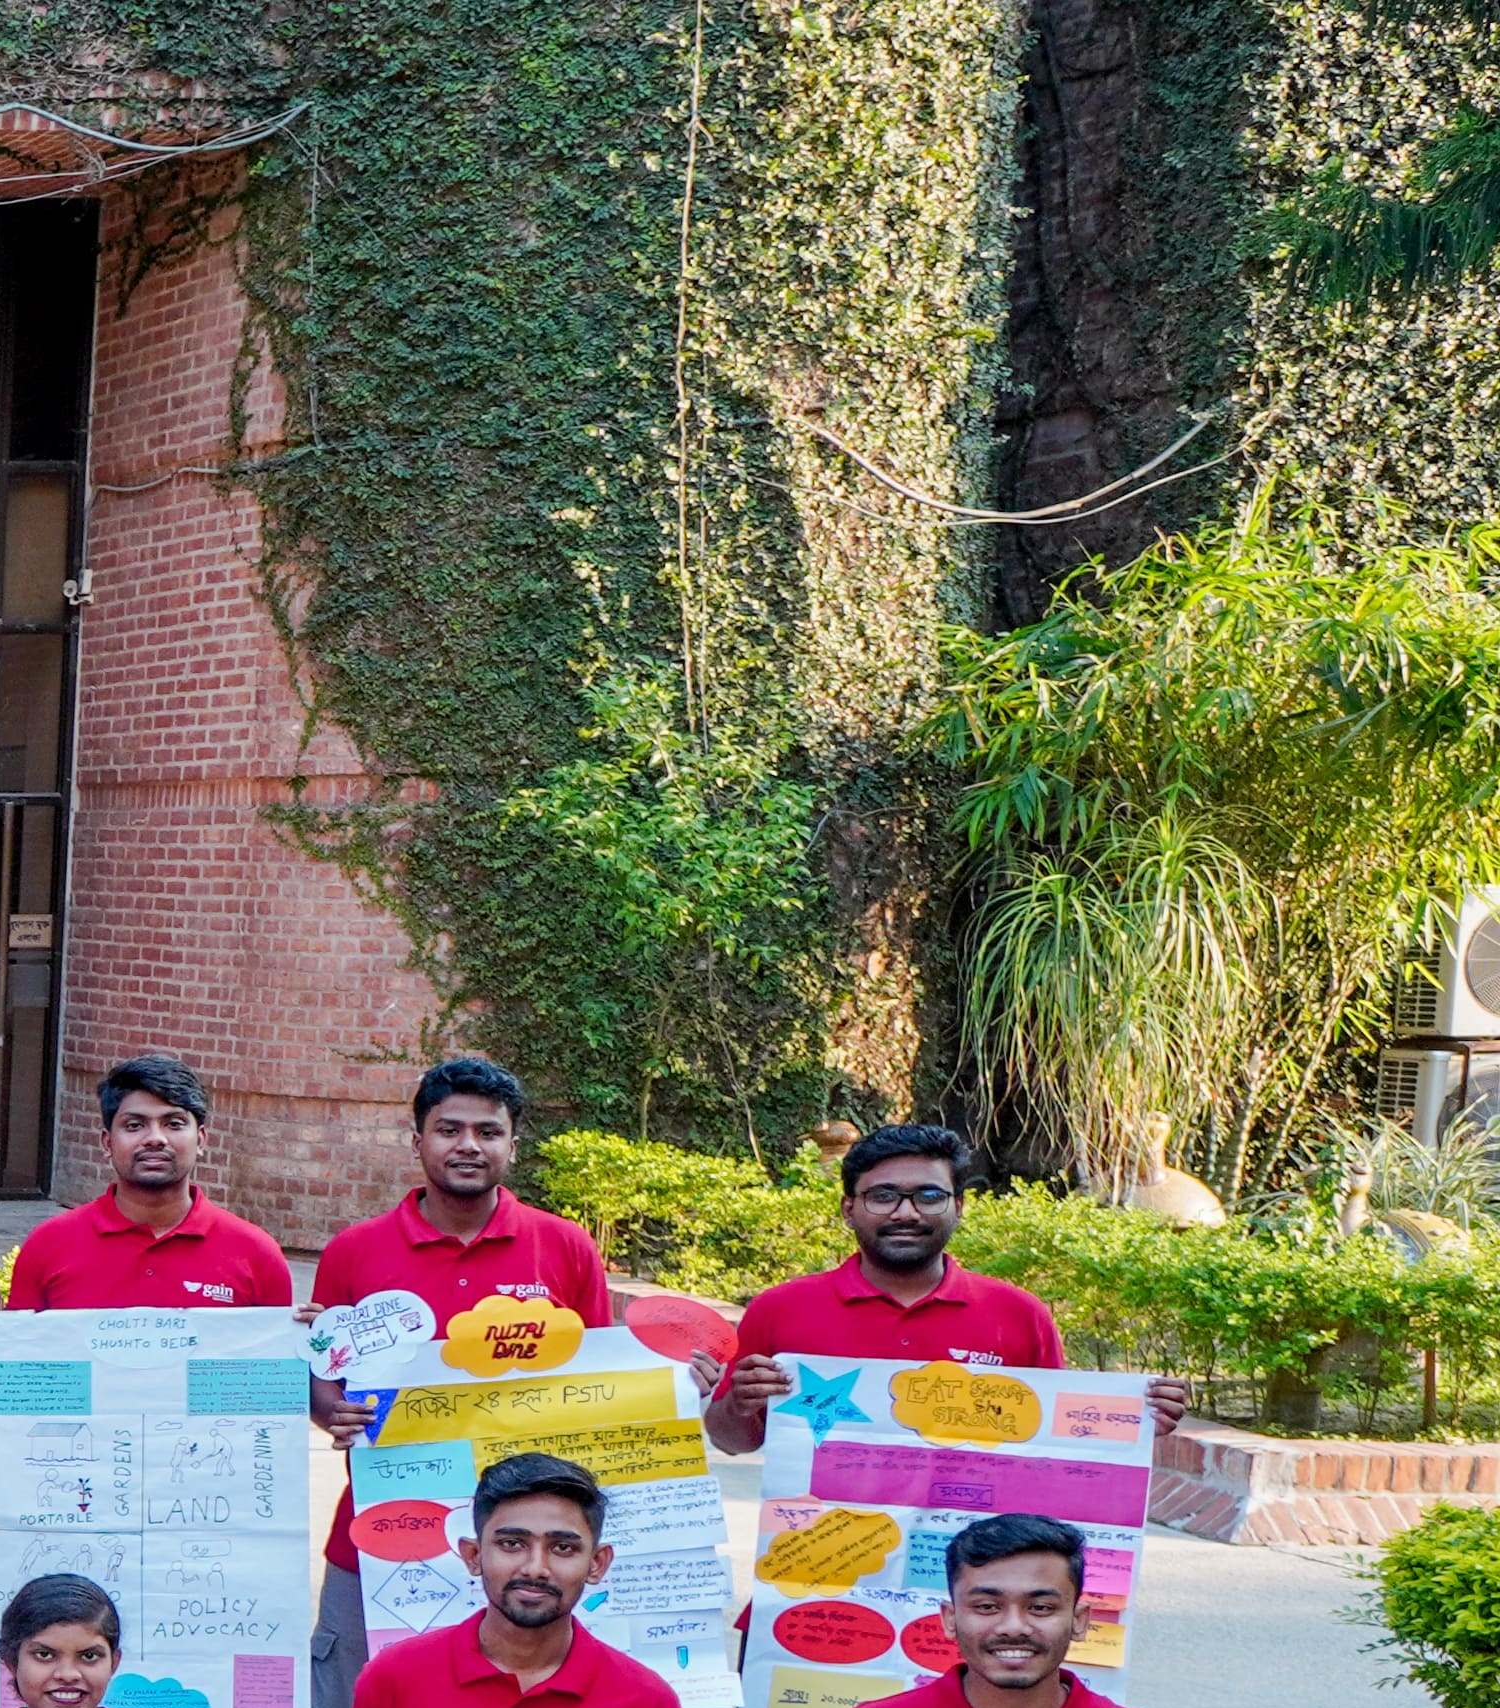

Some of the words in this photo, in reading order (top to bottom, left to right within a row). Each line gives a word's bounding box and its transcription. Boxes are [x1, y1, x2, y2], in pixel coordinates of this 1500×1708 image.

[203, 1283, 234, 1300] gain
[97, 1318, 149, 1333] CHOLTI
[154, 1318, 187, 1331] BARI
[159, 1336, 199, 1350] BEDE
[969, 1351, 1003, 1367] gain
[562, 1383, 617, 1406] PSTU
[906, 1376, 965, 1406] EAT
[113, 1428, 134, 1518] GARDENS
[19, 1511, 95, 1528] PORTABLE
[147, 1495, 232, 1527] LAND
[176, 1597, 259, 1618] POLICY
[152, 1622, 281, 1642] ADVOCACY
